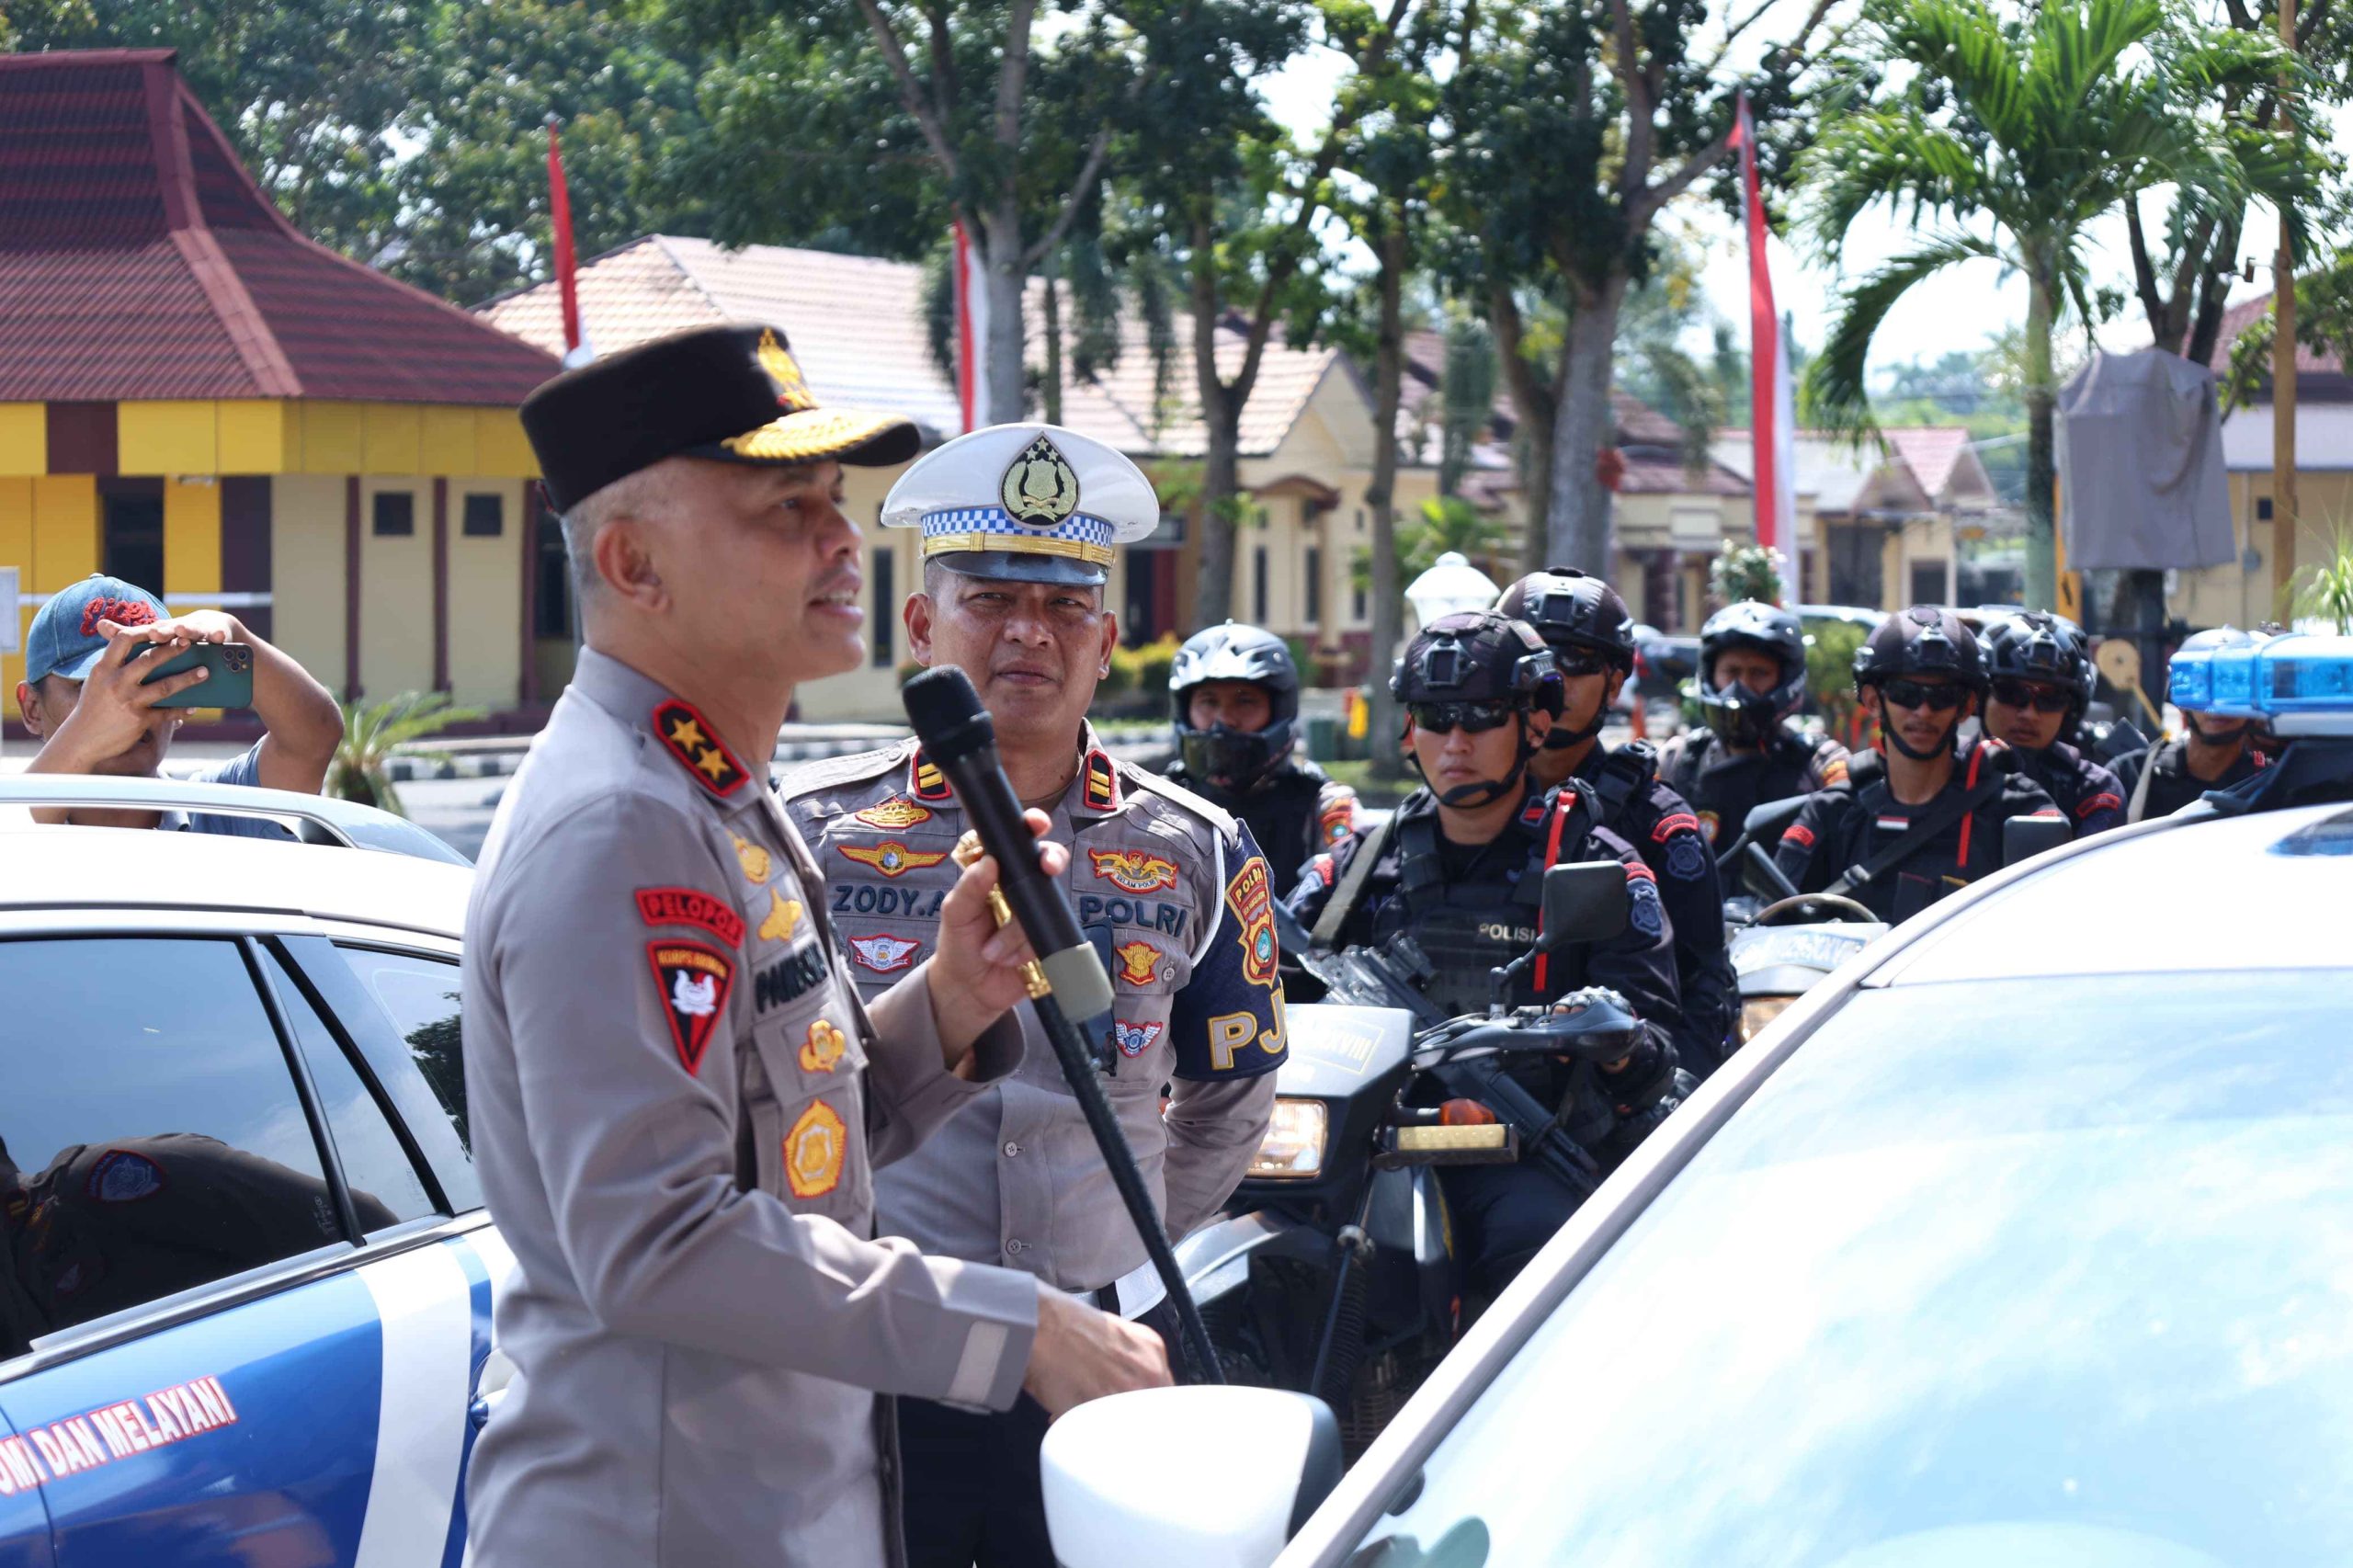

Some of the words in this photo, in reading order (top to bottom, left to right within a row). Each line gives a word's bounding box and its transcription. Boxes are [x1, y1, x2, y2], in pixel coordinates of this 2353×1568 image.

[1234, 867, 1264, 903] POLDA
[1079, 895, 1188, 937] POLRI
[27, 1415, 109, 1480] DAN
[86, 1373, 239, 1460] MELAYANI
